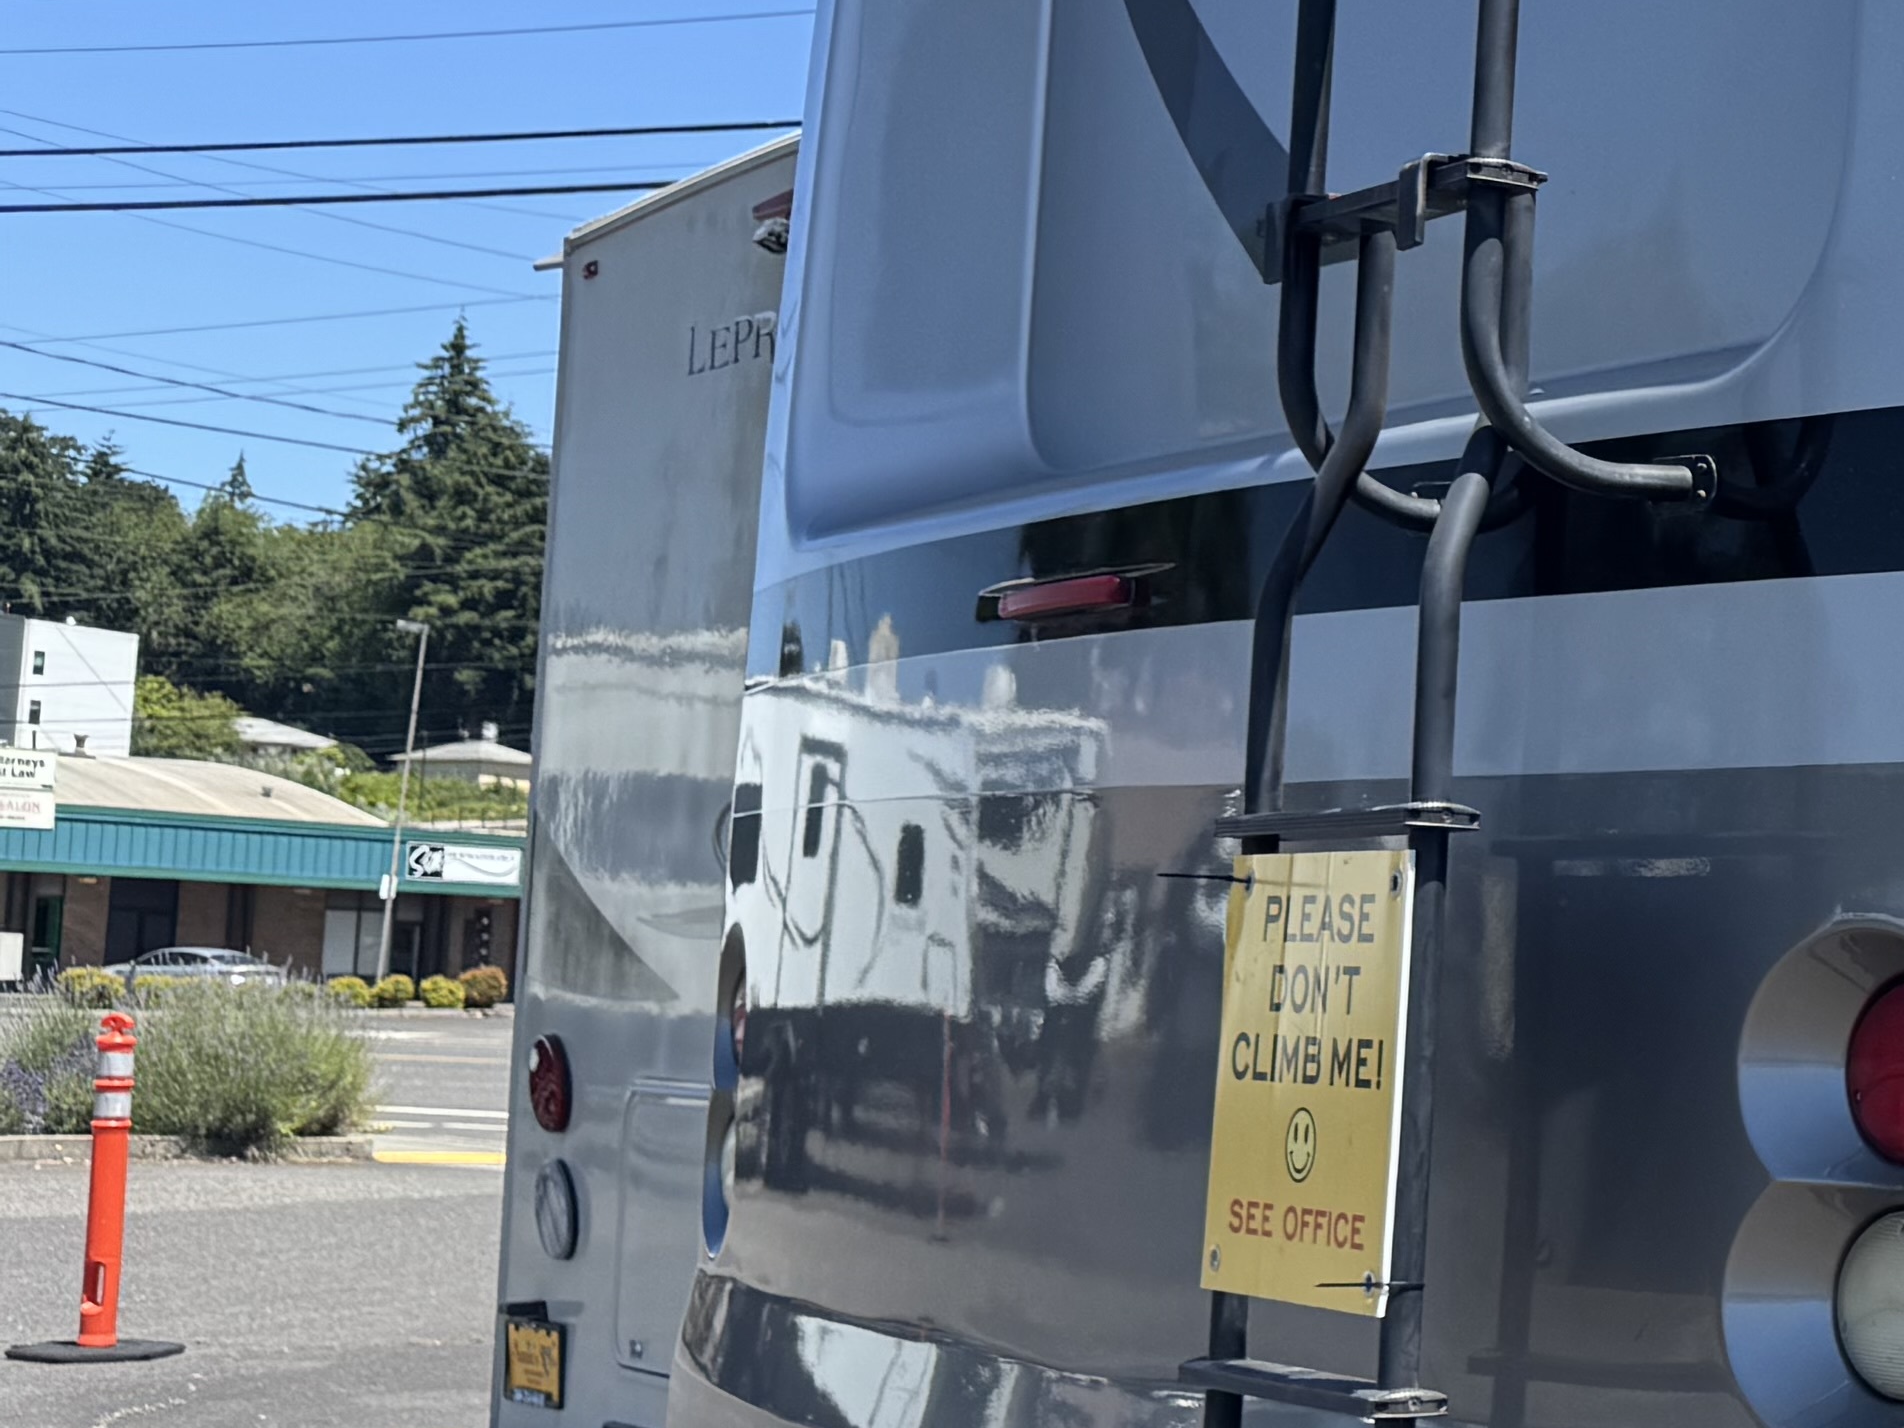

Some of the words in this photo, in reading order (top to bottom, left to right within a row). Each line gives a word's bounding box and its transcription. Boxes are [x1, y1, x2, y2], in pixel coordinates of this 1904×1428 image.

[11, 767, 35, 778] Law
[1263, 893, 1377, 943] PLEASE
[1269, 964, 1361, 1015] DON'T
[1232, 1031, 1320, 1084] CLIMB
[1329, 1037, 1383, 1090] ME!
[1228, 1197, 1274, 1238] SEE
[1283, 1206, 1366, 1251] OFFICE
